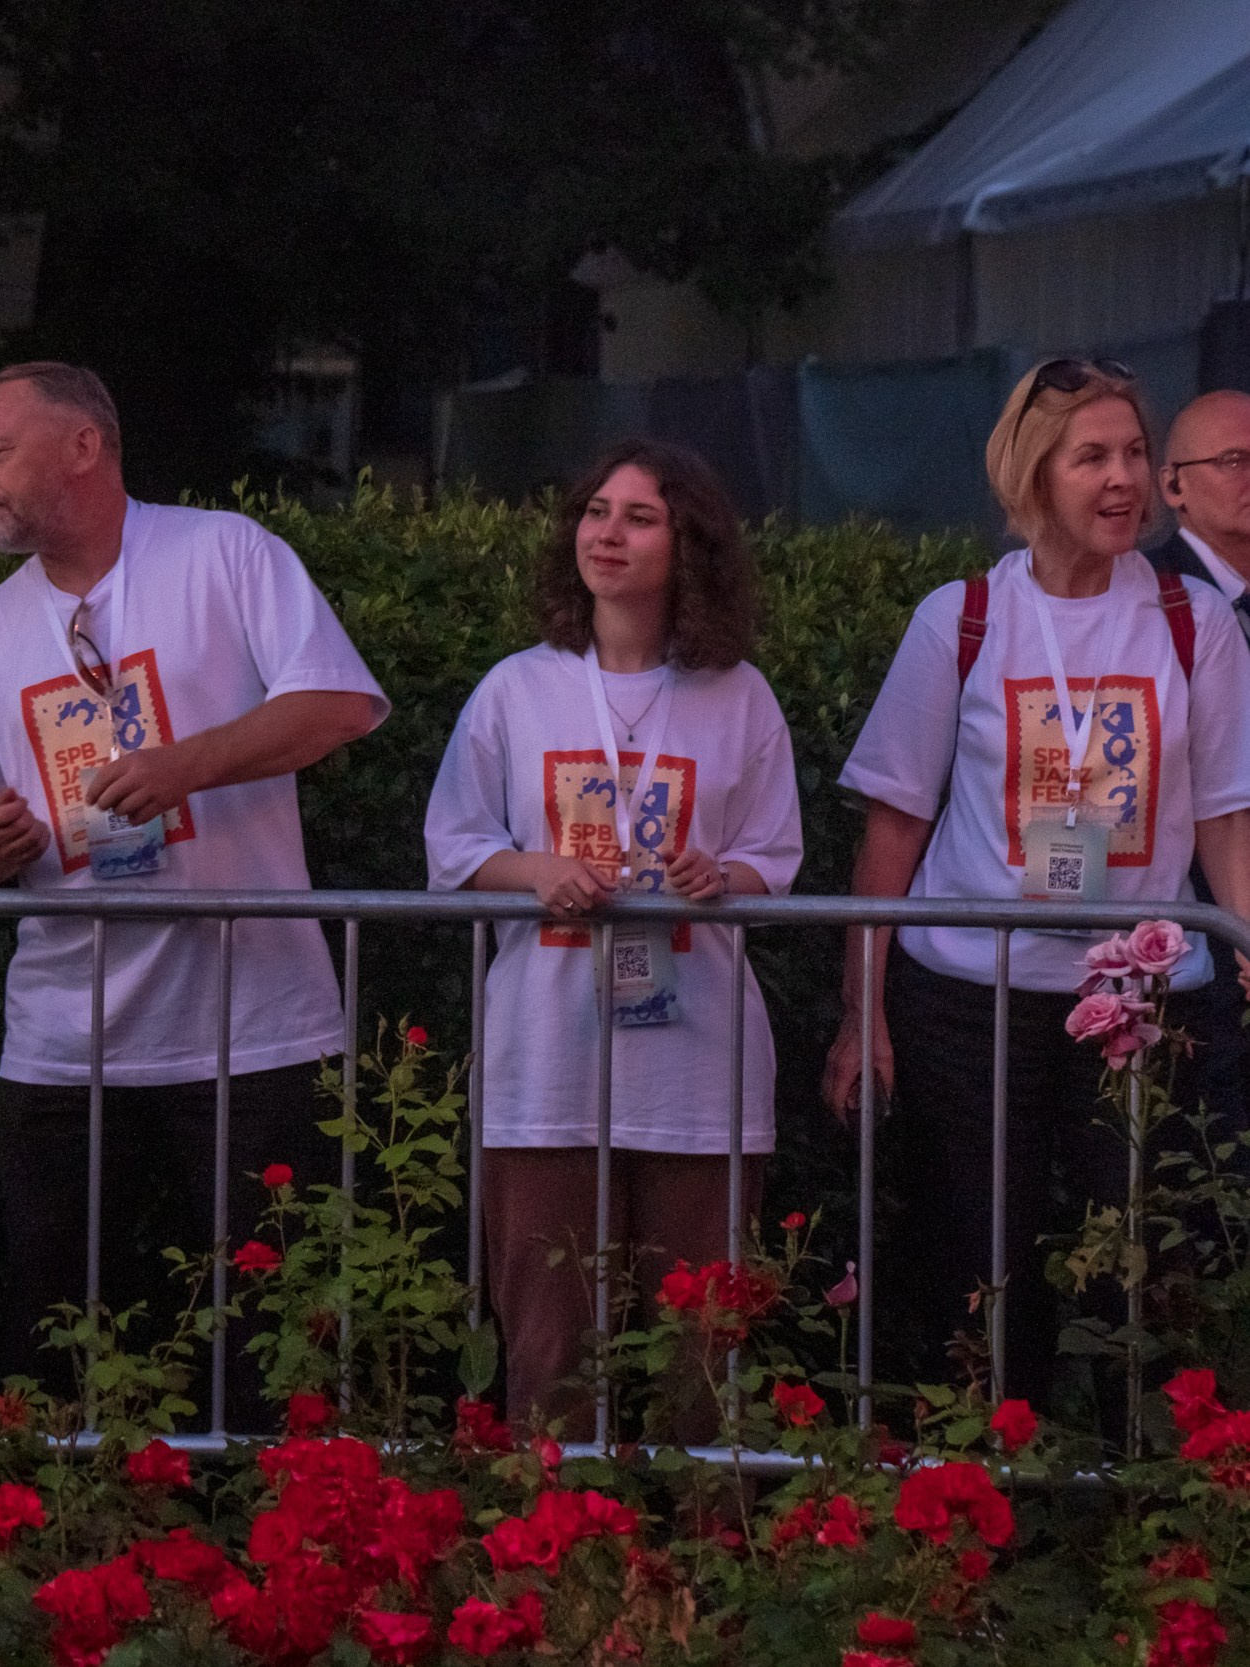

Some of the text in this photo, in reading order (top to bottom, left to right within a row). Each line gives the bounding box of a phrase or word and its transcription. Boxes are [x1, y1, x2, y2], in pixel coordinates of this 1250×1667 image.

[54, 741, 97, 768] SPB
[62, 785, 84, 809] FE
[568, 823, 613, 842] SPB
[570, 842, 625, 862] JAZZ
